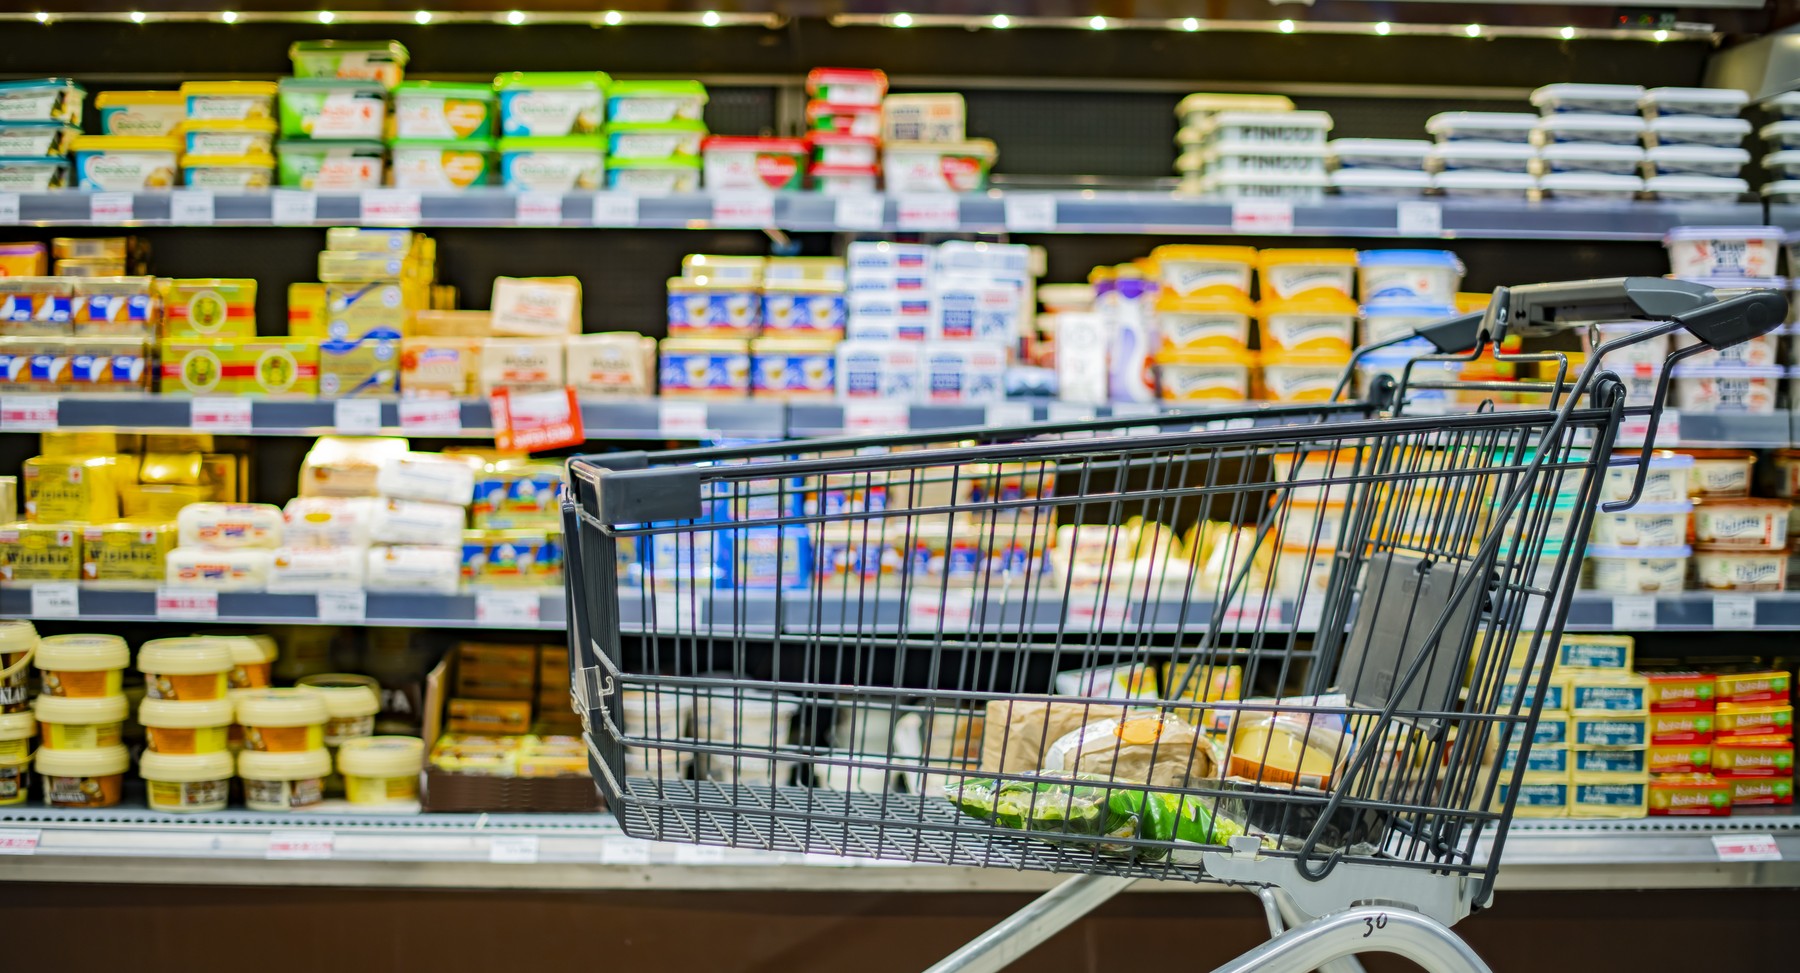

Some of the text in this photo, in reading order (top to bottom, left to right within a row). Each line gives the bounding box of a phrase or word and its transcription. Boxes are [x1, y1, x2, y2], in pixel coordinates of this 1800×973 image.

[6, 550, 70, 566] Wiejskie
[90, 549, 153, 564] Wiejskie
[1363, 912, 1388, 938] 30
